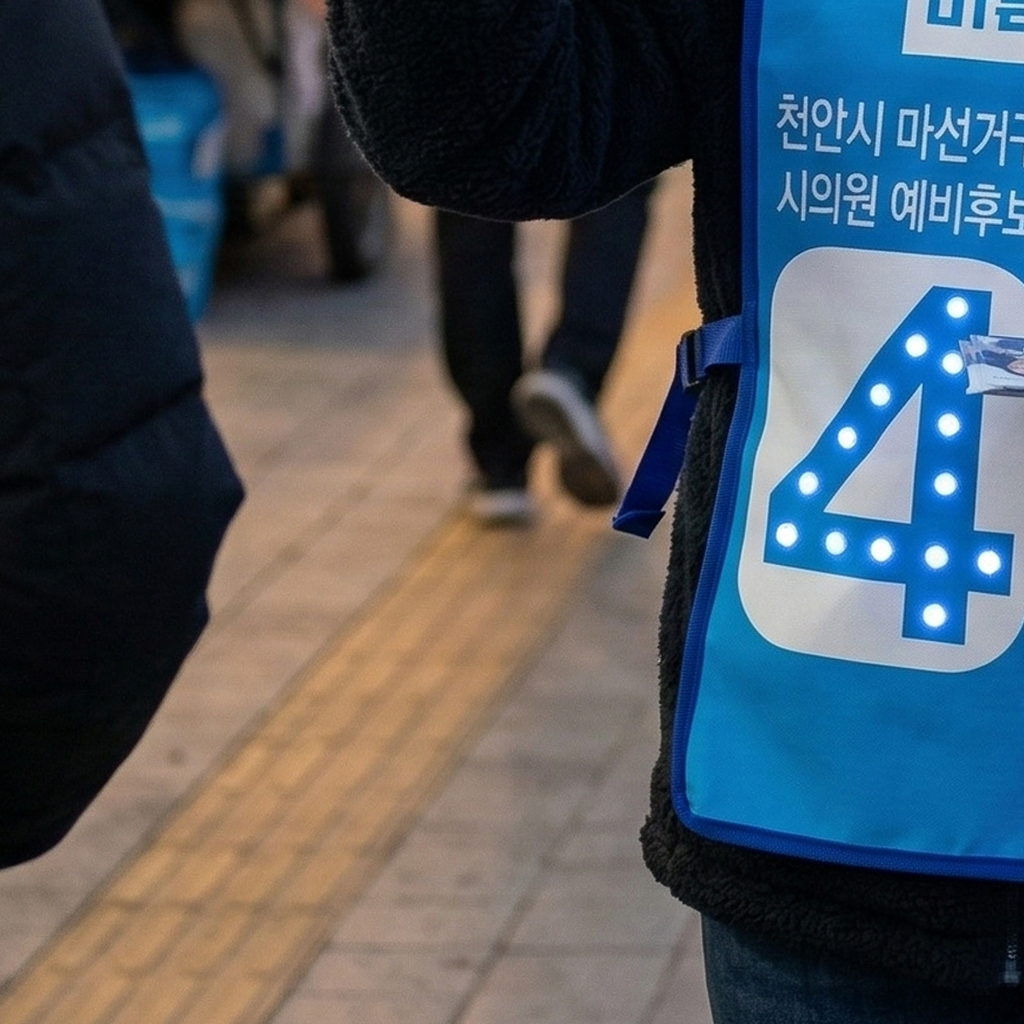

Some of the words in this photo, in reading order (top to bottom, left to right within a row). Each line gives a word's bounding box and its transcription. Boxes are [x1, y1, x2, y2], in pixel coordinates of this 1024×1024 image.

[776, 93, 885, 158] 천안시
[776, 169, 879, 228] 시의원
[763, 285, 1015, 646] 4
